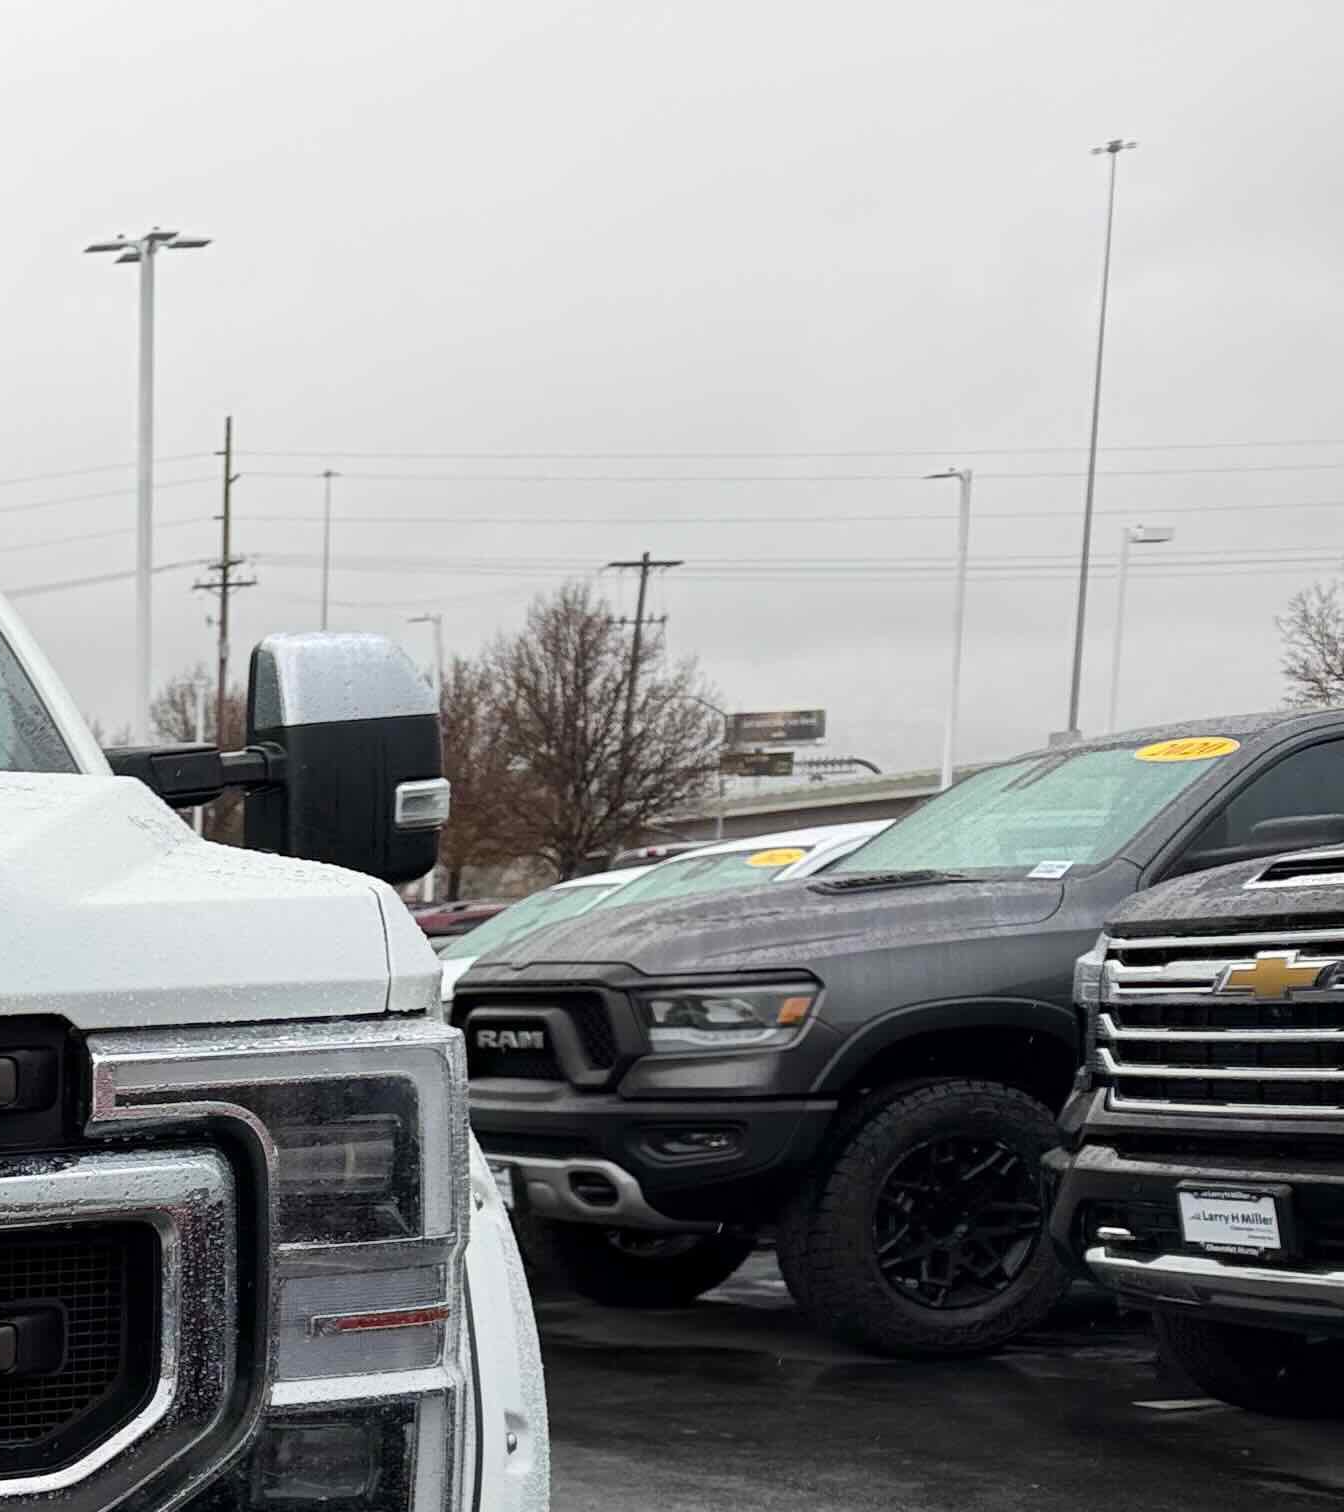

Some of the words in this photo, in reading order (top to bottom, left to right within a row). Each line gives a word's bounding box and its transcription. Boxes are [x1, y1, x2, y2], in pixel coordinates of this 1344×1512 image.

[477, 1029, 544, 1049] RAM
[1202, 1209, 1229, 1224] Larry
[1231, 1213, 1240, 1223] H
[1240, 1213, 1273, 1225] Miller
